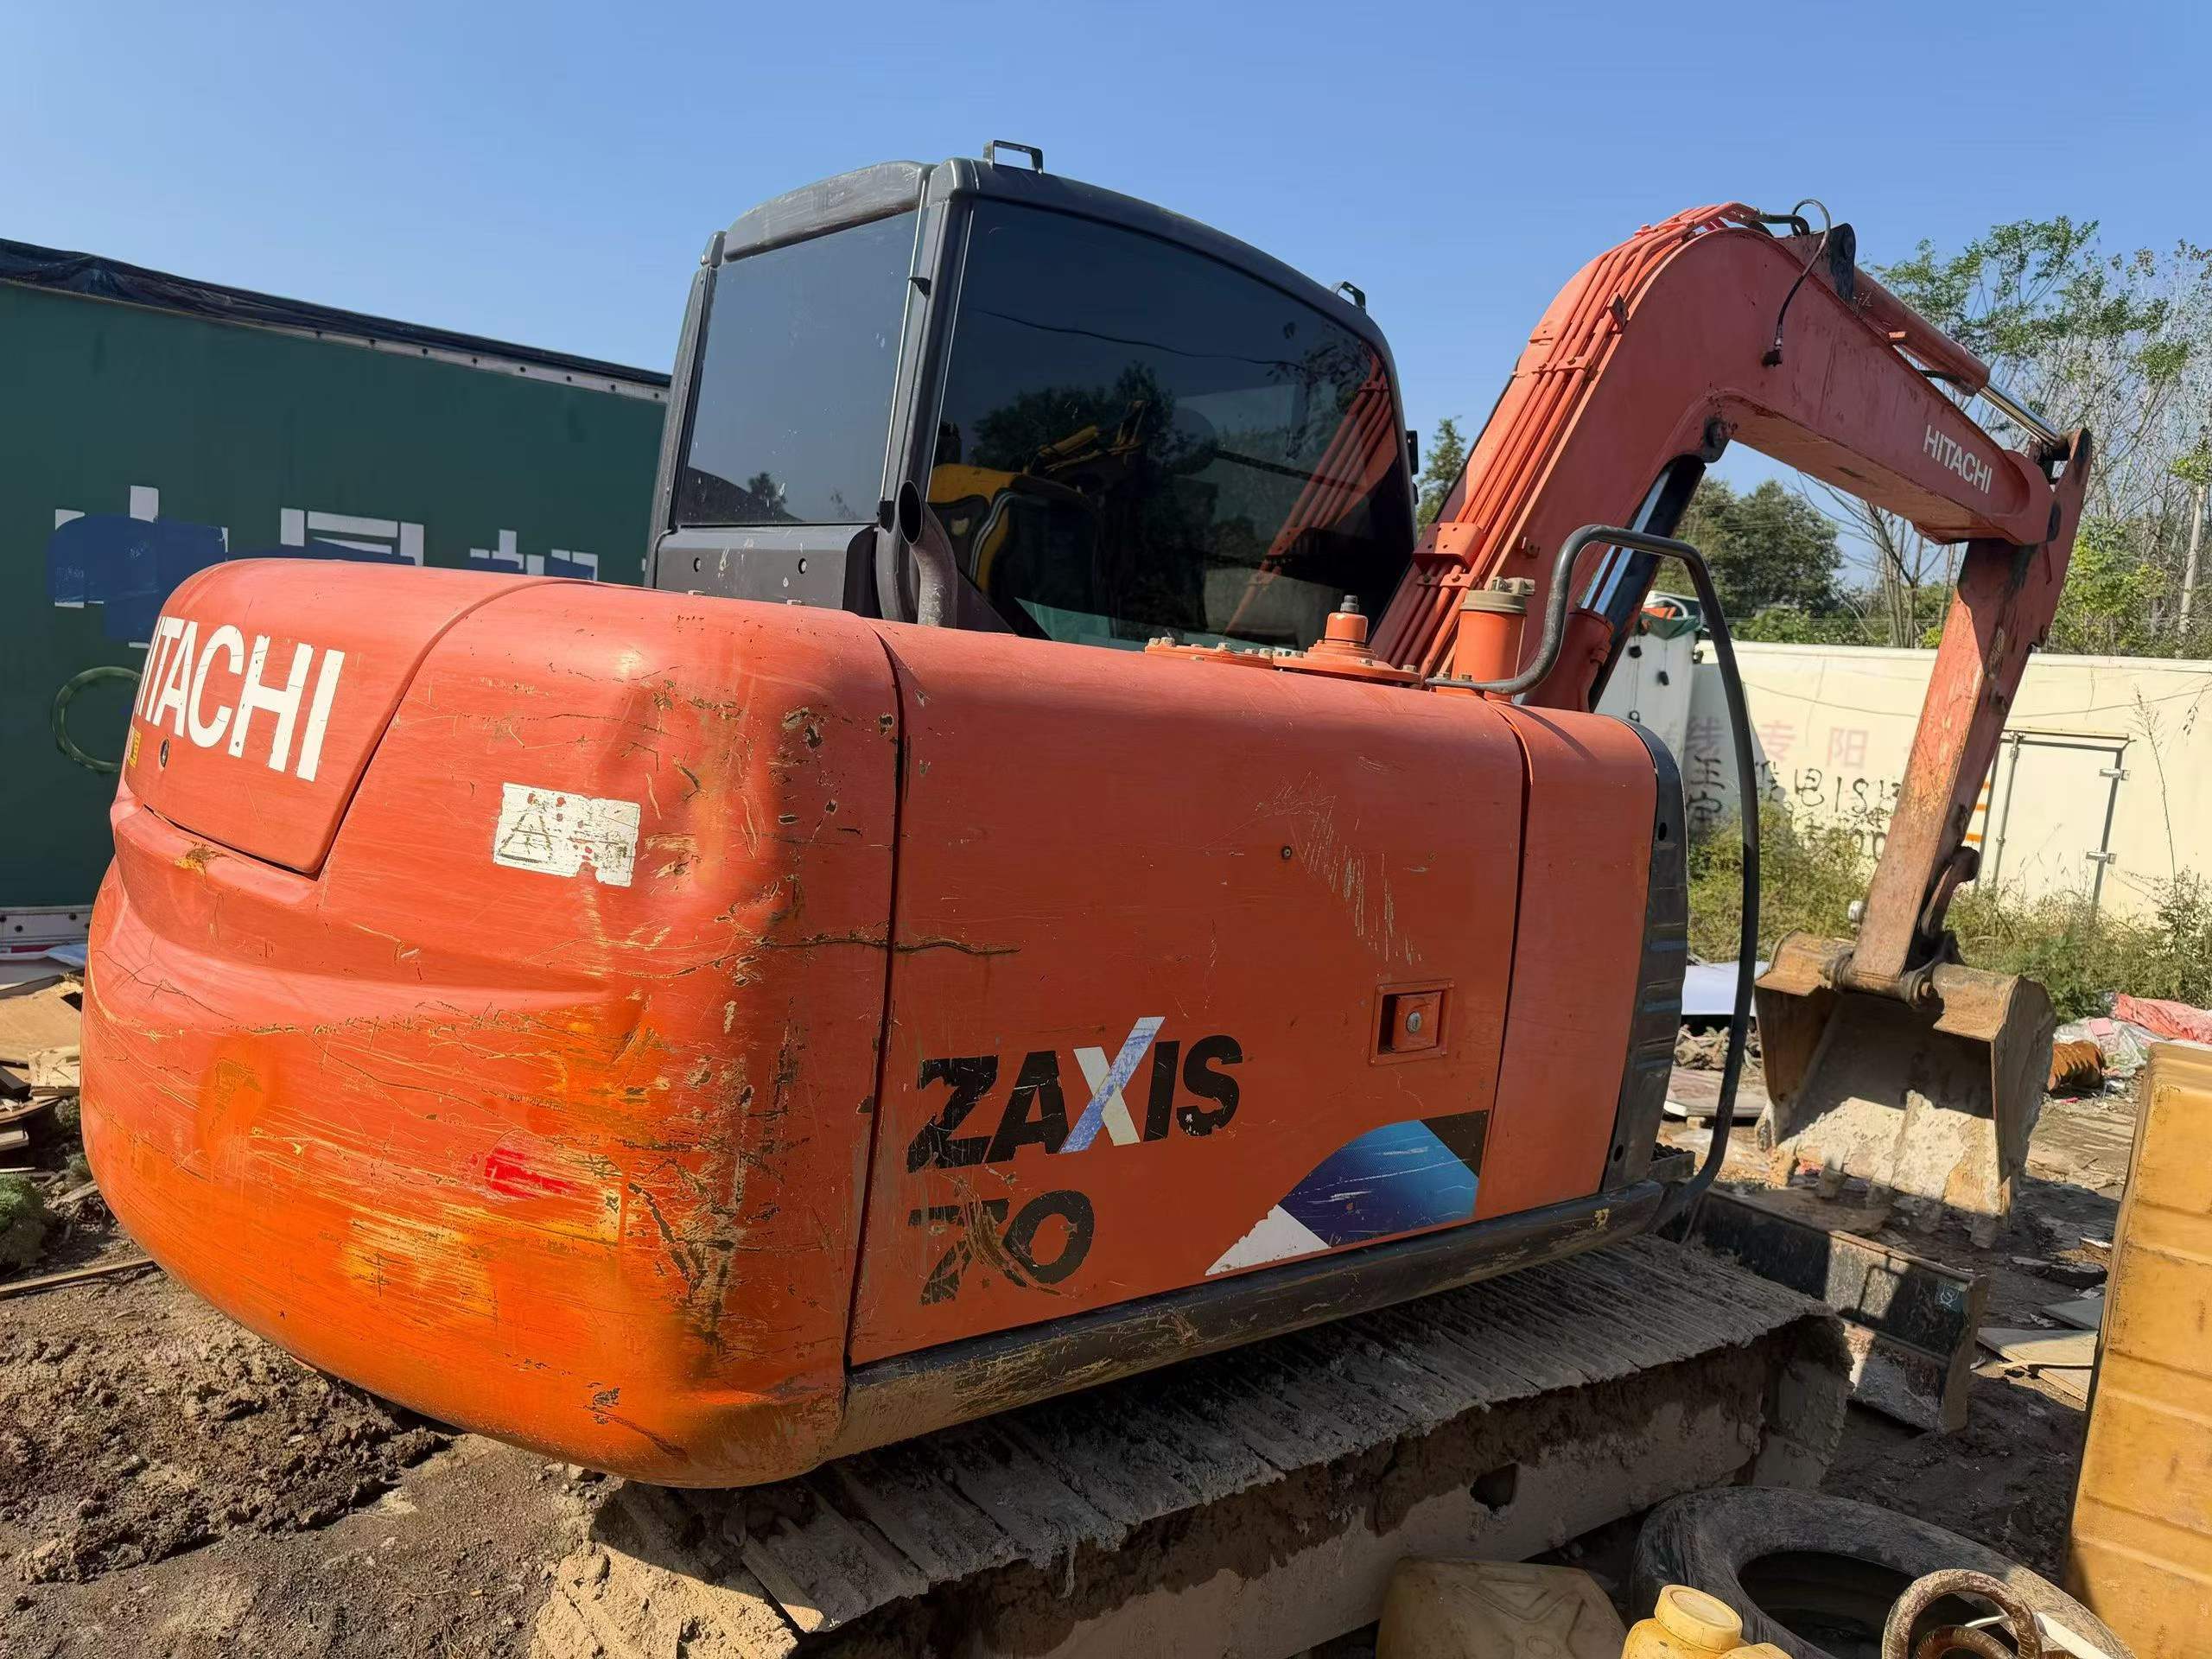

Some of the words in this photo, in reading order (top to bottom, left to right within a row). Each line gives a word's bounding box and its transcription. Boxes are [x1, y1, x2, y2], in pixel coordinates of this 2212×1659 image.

[1923, 424, 1993, 494] HITACHI
[136, 615, 346, 782] ITACHI
[906, 1016, 1243, 1173] ZAXIS
[907, 1190, 1095, 1306] 70
